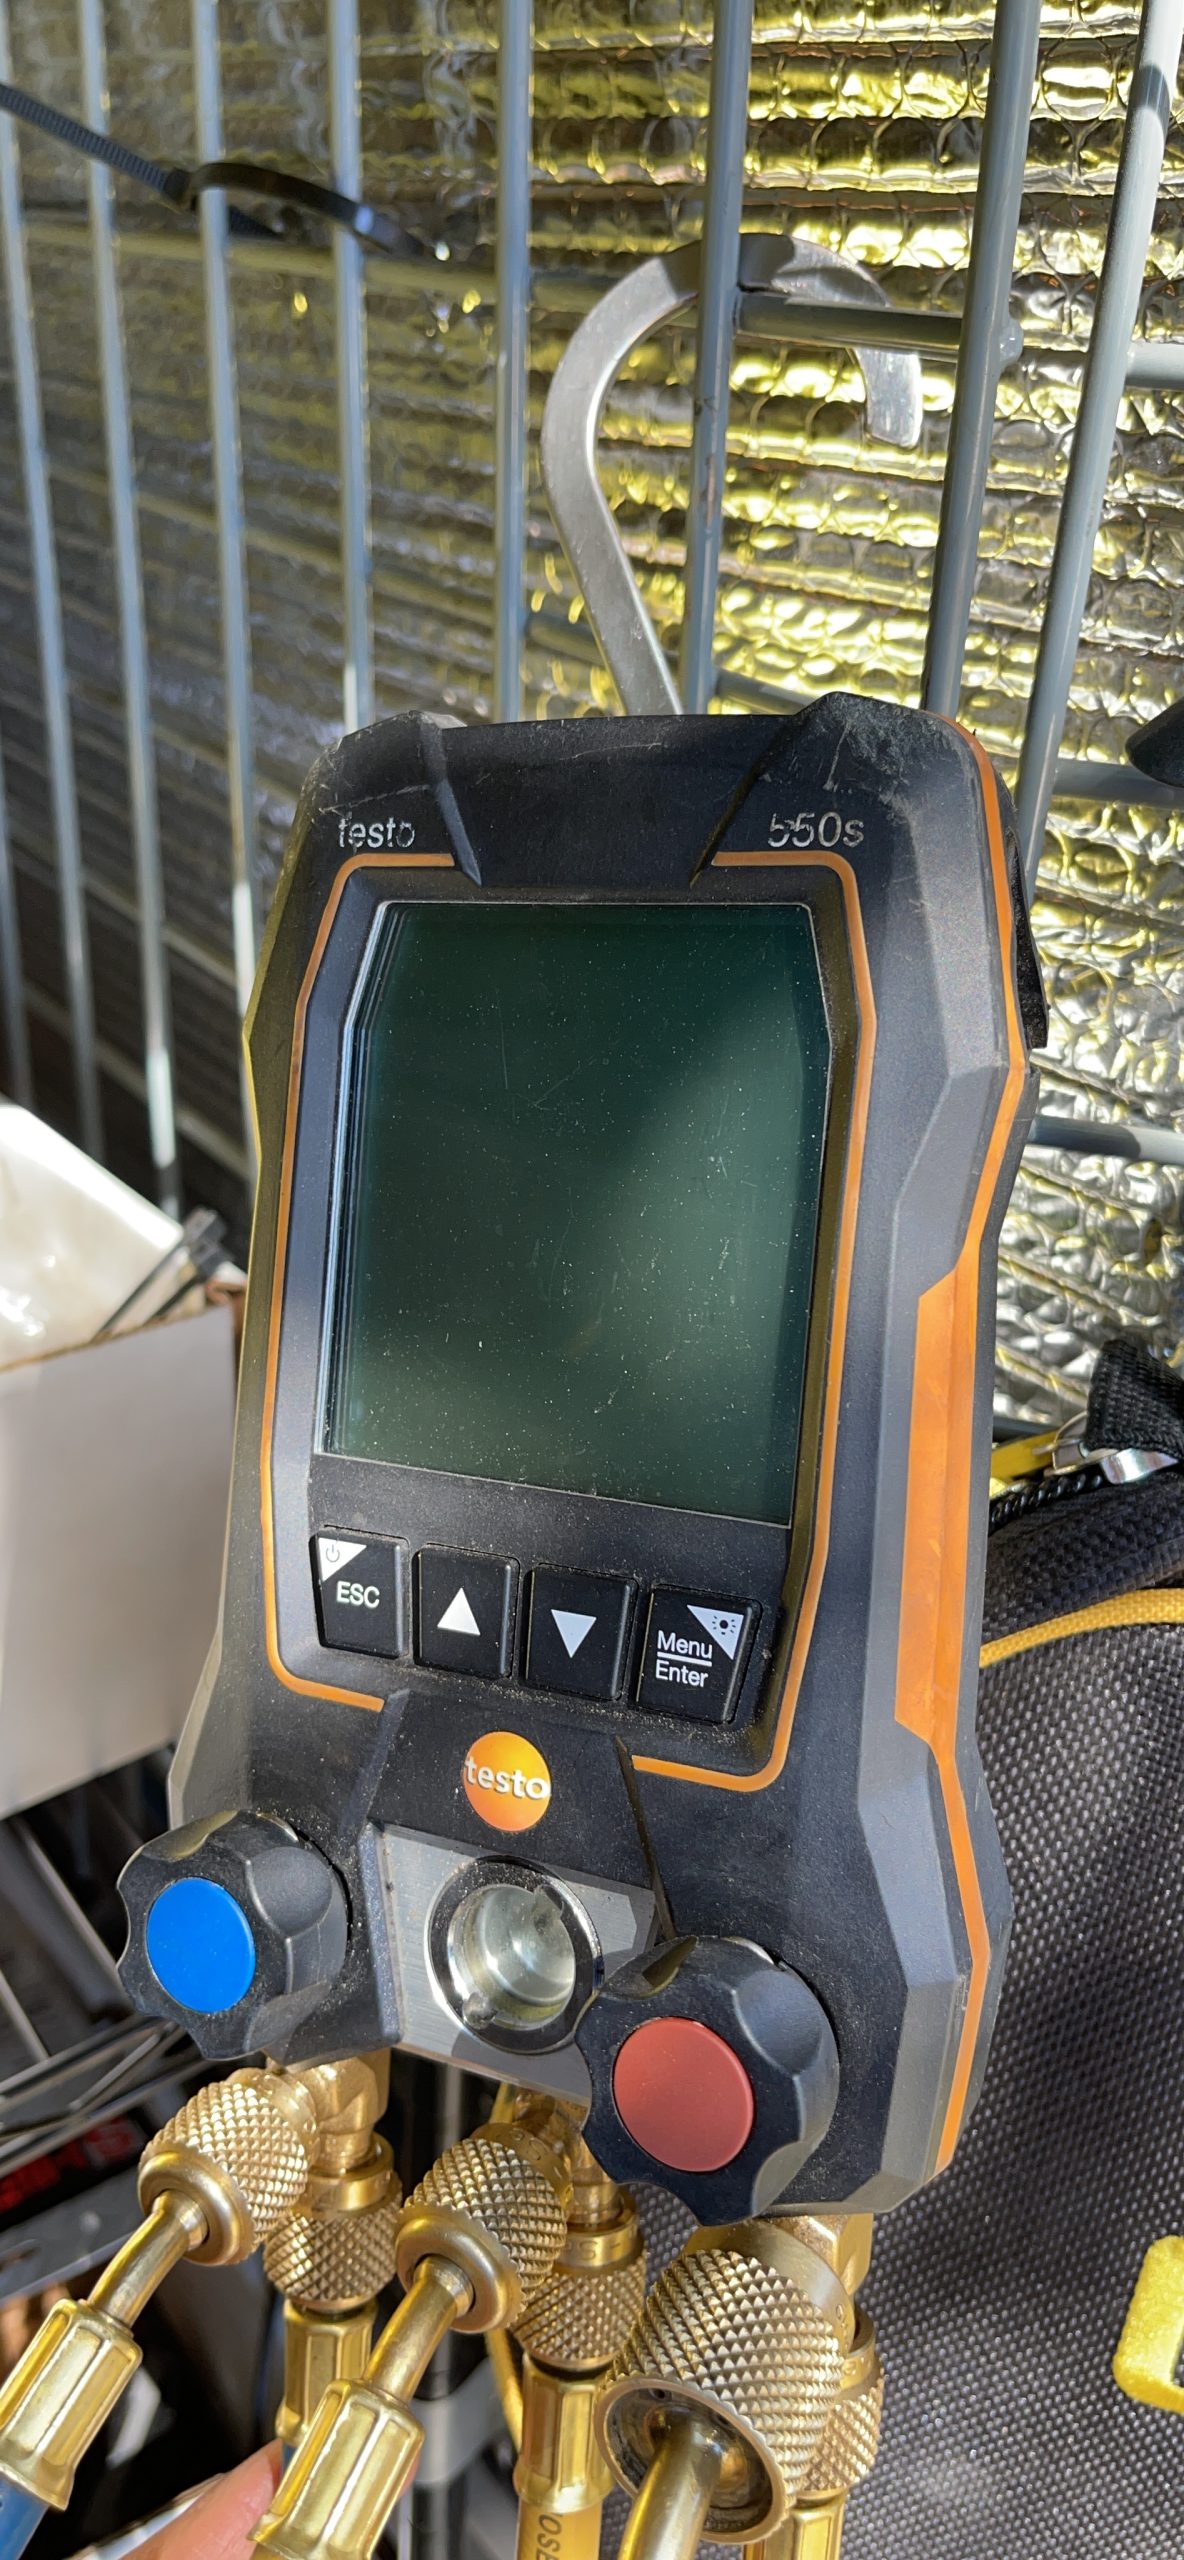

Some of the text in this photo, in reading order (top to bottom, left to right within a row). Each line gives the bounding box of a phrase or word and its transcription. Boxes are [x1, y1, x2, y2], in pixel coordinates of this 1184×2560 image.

[338, 816, 415, 848] testo
[336, 1580, 380, 1609] ESC
[657, 1630, 713, 1659] Menu
[655, 1659, 709, 1688] Enter
[464, 1755, 552, 1800] testo
